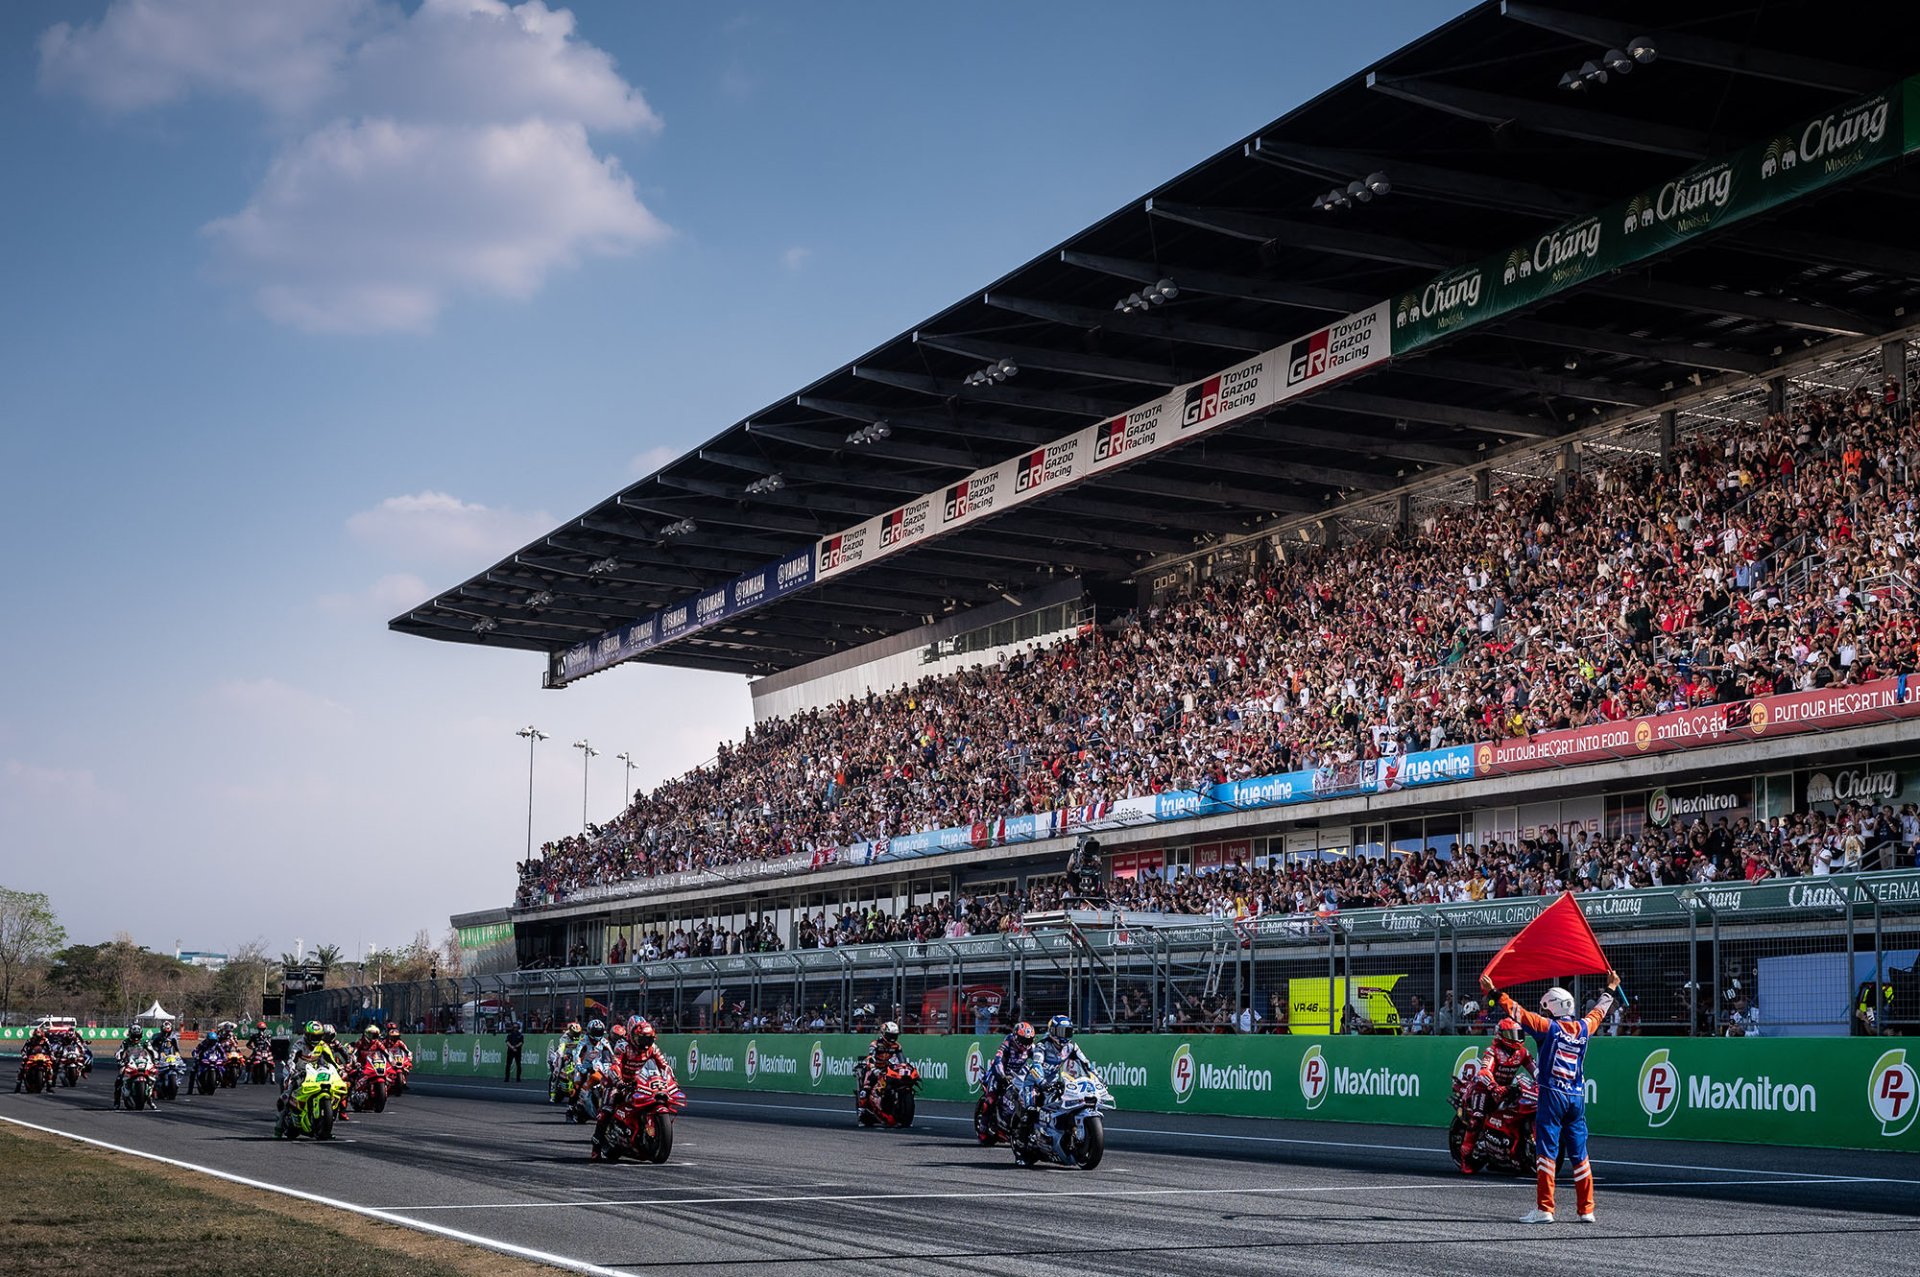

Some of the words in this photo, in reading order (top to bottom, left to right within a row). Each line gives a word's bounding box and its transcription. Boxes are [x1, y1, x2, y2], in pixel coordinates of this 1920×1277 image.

[1799, 101, 1889, 163] Chang
[1656, 167, 1733, 223] Chang
[1533, 221, 1601, 273] Chang
[1422, 273, 1482, 318] Chang
[1332, 312, 1377, 339] TOYOTA
[1330, 329, 1372, 354] GAZOO
[1287, 347, 1328, 388] GR
[1328, 345, 1370, 368] Racing
[1223, 362, 1263, 386] TOYOTA
[1221, 377, 1258, 399] GAZOO
[1181, 392, 1218, 429] GR
[1219, 392, 1256, 413] Racing
[1128, 403, 1162, 425] TOYOTA
[1126, 418, 1158, 438] GAZOO
[1047, 438, 1078, 458] TOYOTA
[1094, 431, 1125, 463] GR
[1125, 431, 1155, 450] Racing
[1045, 452, 1074, 470] GAZOO
[969, 471, 999, 489] TOYOTA
[1015, 464, 1043, 494] GR
[1043, 465, 1072, 482] Racing
[968, 483, 995, 500] GAZOO
[905, 500, 929, 517] TOYOTA
[943, 495, 968, 523] GR
[967, 496, 993, 513] Racing
[902, 523, 924, 539] Racing
[903, 512, 926, 528] GAZOO
[842, 539, 864, 553] GAZOO
[844, 527, 867, 543] TOYOTA
[784, 554, 809, 580] YAMAHA
[840, 549, 862, 564] Racing
[742, 573, 765, 597] YAMAHA
[779, 575, 808, 591] RACING
[702, 589, 725, 615] YAMAHA
[737, 593, 763, 607] RACING
[667, 606, 688, 629] YAMAHA
[634, 620, 653, 643] YAMAHA
[1774, 703, 1798, 722] PUT
[1800, 701, 1826, 718] OUR
[1496, 749, 1515, 763] PUT
[1516, 745, 1536, 761] OUR
[1576, 736, 1600, 753] INTO
[1601, 731, 1629, 748] FOOD
[1405, 761, 1430, 783] rue
[1432, 754, 1470, 779] online
[1233, 785, 1262, 807] true
[1262, 778, 1293, 802] online
[1834, 769, 1897, 799] Chang
[1161, 796, 1185, 818] true
[1671, 793, 1738, 815] Maxnitron
[940, 832, 958, 848] true
[1011, 820, 1033, 839] online
[893, 840, 910, 855] true
[910, 835, 929, 851] online
[1200, 849, 1217, 863] true
[1602, 894, 1642, 916] Chang
[700, 1053, 734, 1073] Maxnitron
[759, 1054, 797, 1075] Maxnitron
[813, 1051, 821, 1074] PT
[968, 1055, 980, 1083] PT
[1177, 1057, 1191, 1092] PT
[1199, 1063, 1272, 1092] Maxnitron
[1306, 1060, 1323, 1096] PT
[1333, 1066, 1420, 1097] Maxnitron
[1648, 1067, 1672, 1111] PT
[1687, 1074, 1817, 1113] Maxnitron
[1879, 1070, 1910, 1118] PT
